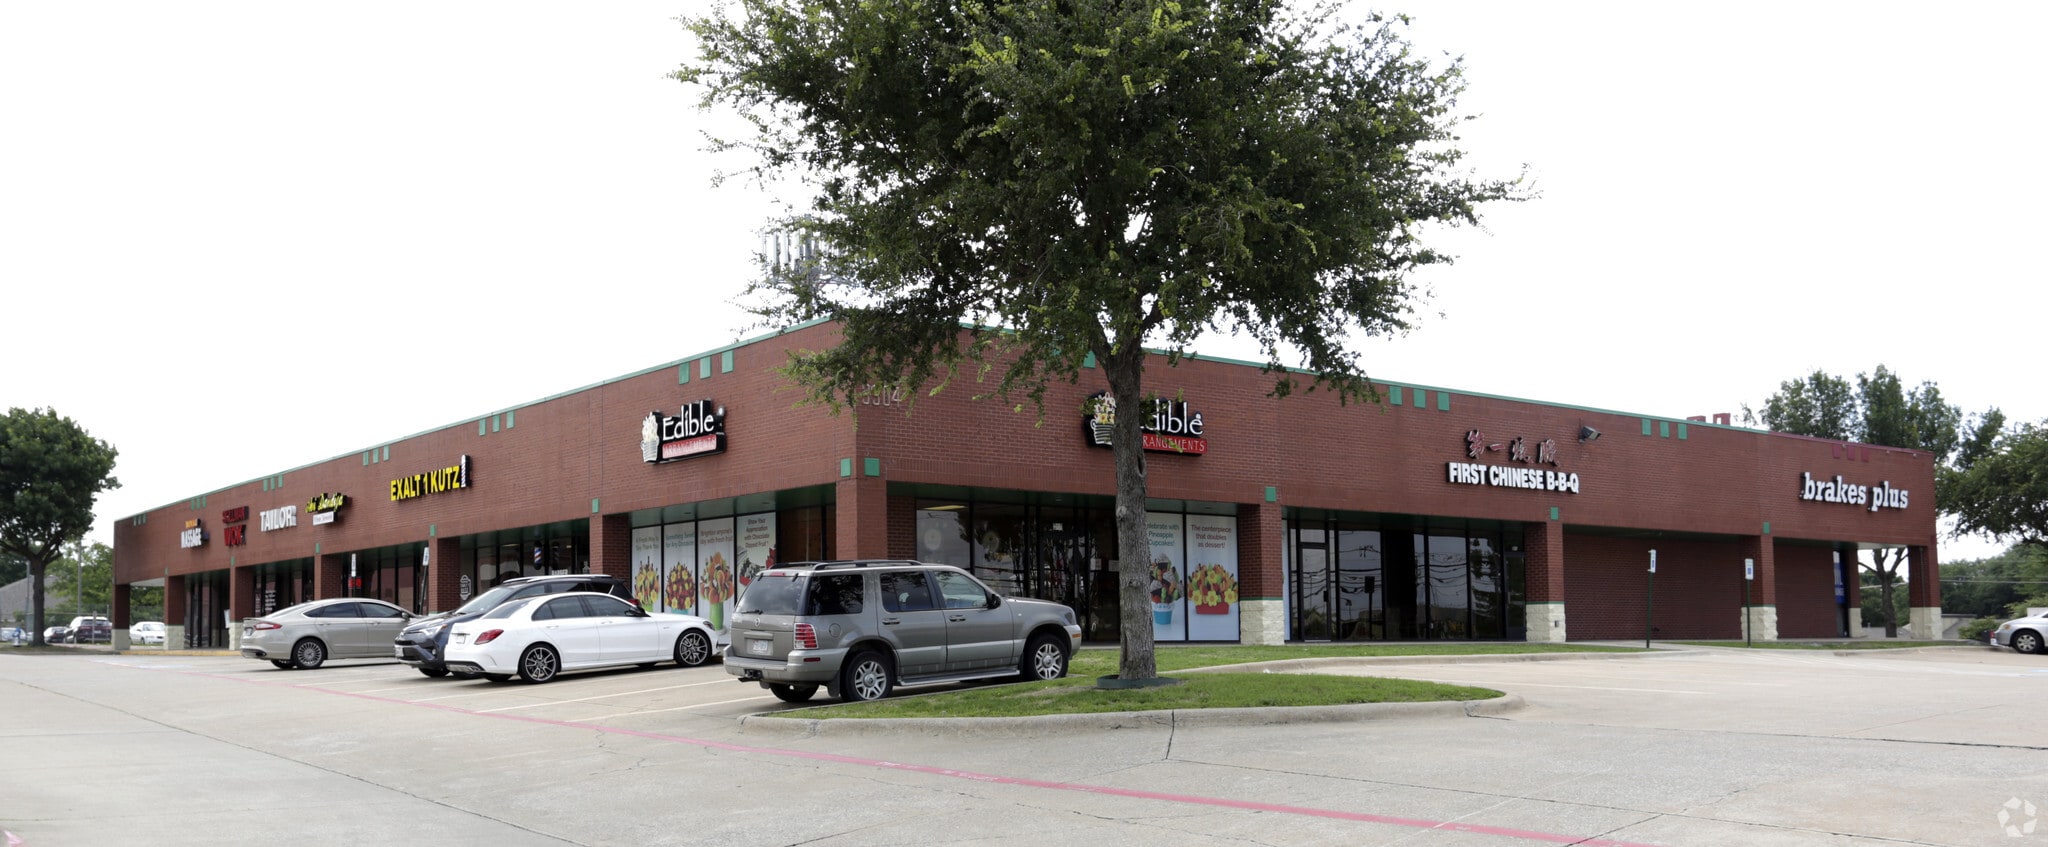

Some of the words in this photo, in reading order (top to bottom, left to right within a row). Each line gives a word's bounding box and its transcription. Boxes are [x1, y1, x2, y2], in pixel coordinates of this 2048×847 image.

[662, 400, 714, 441] Edible
[1141, 398, 1203, 435] dible
[390, 474, 420, 501] EXALT
[423, 472, 428, 495] 1
[430, 465, 460, 493] KUTZ
[1449, 462, 1487, 485] FIRST
[1489, 465, 1545, 490] CHINESE
[1546, 470, 1579, 494] B-B-Q
[1803, 471, 1867, 505] brakes
[1871, 480, 1909, 512] plus
[260, 505, 295, 532] TAILOR
